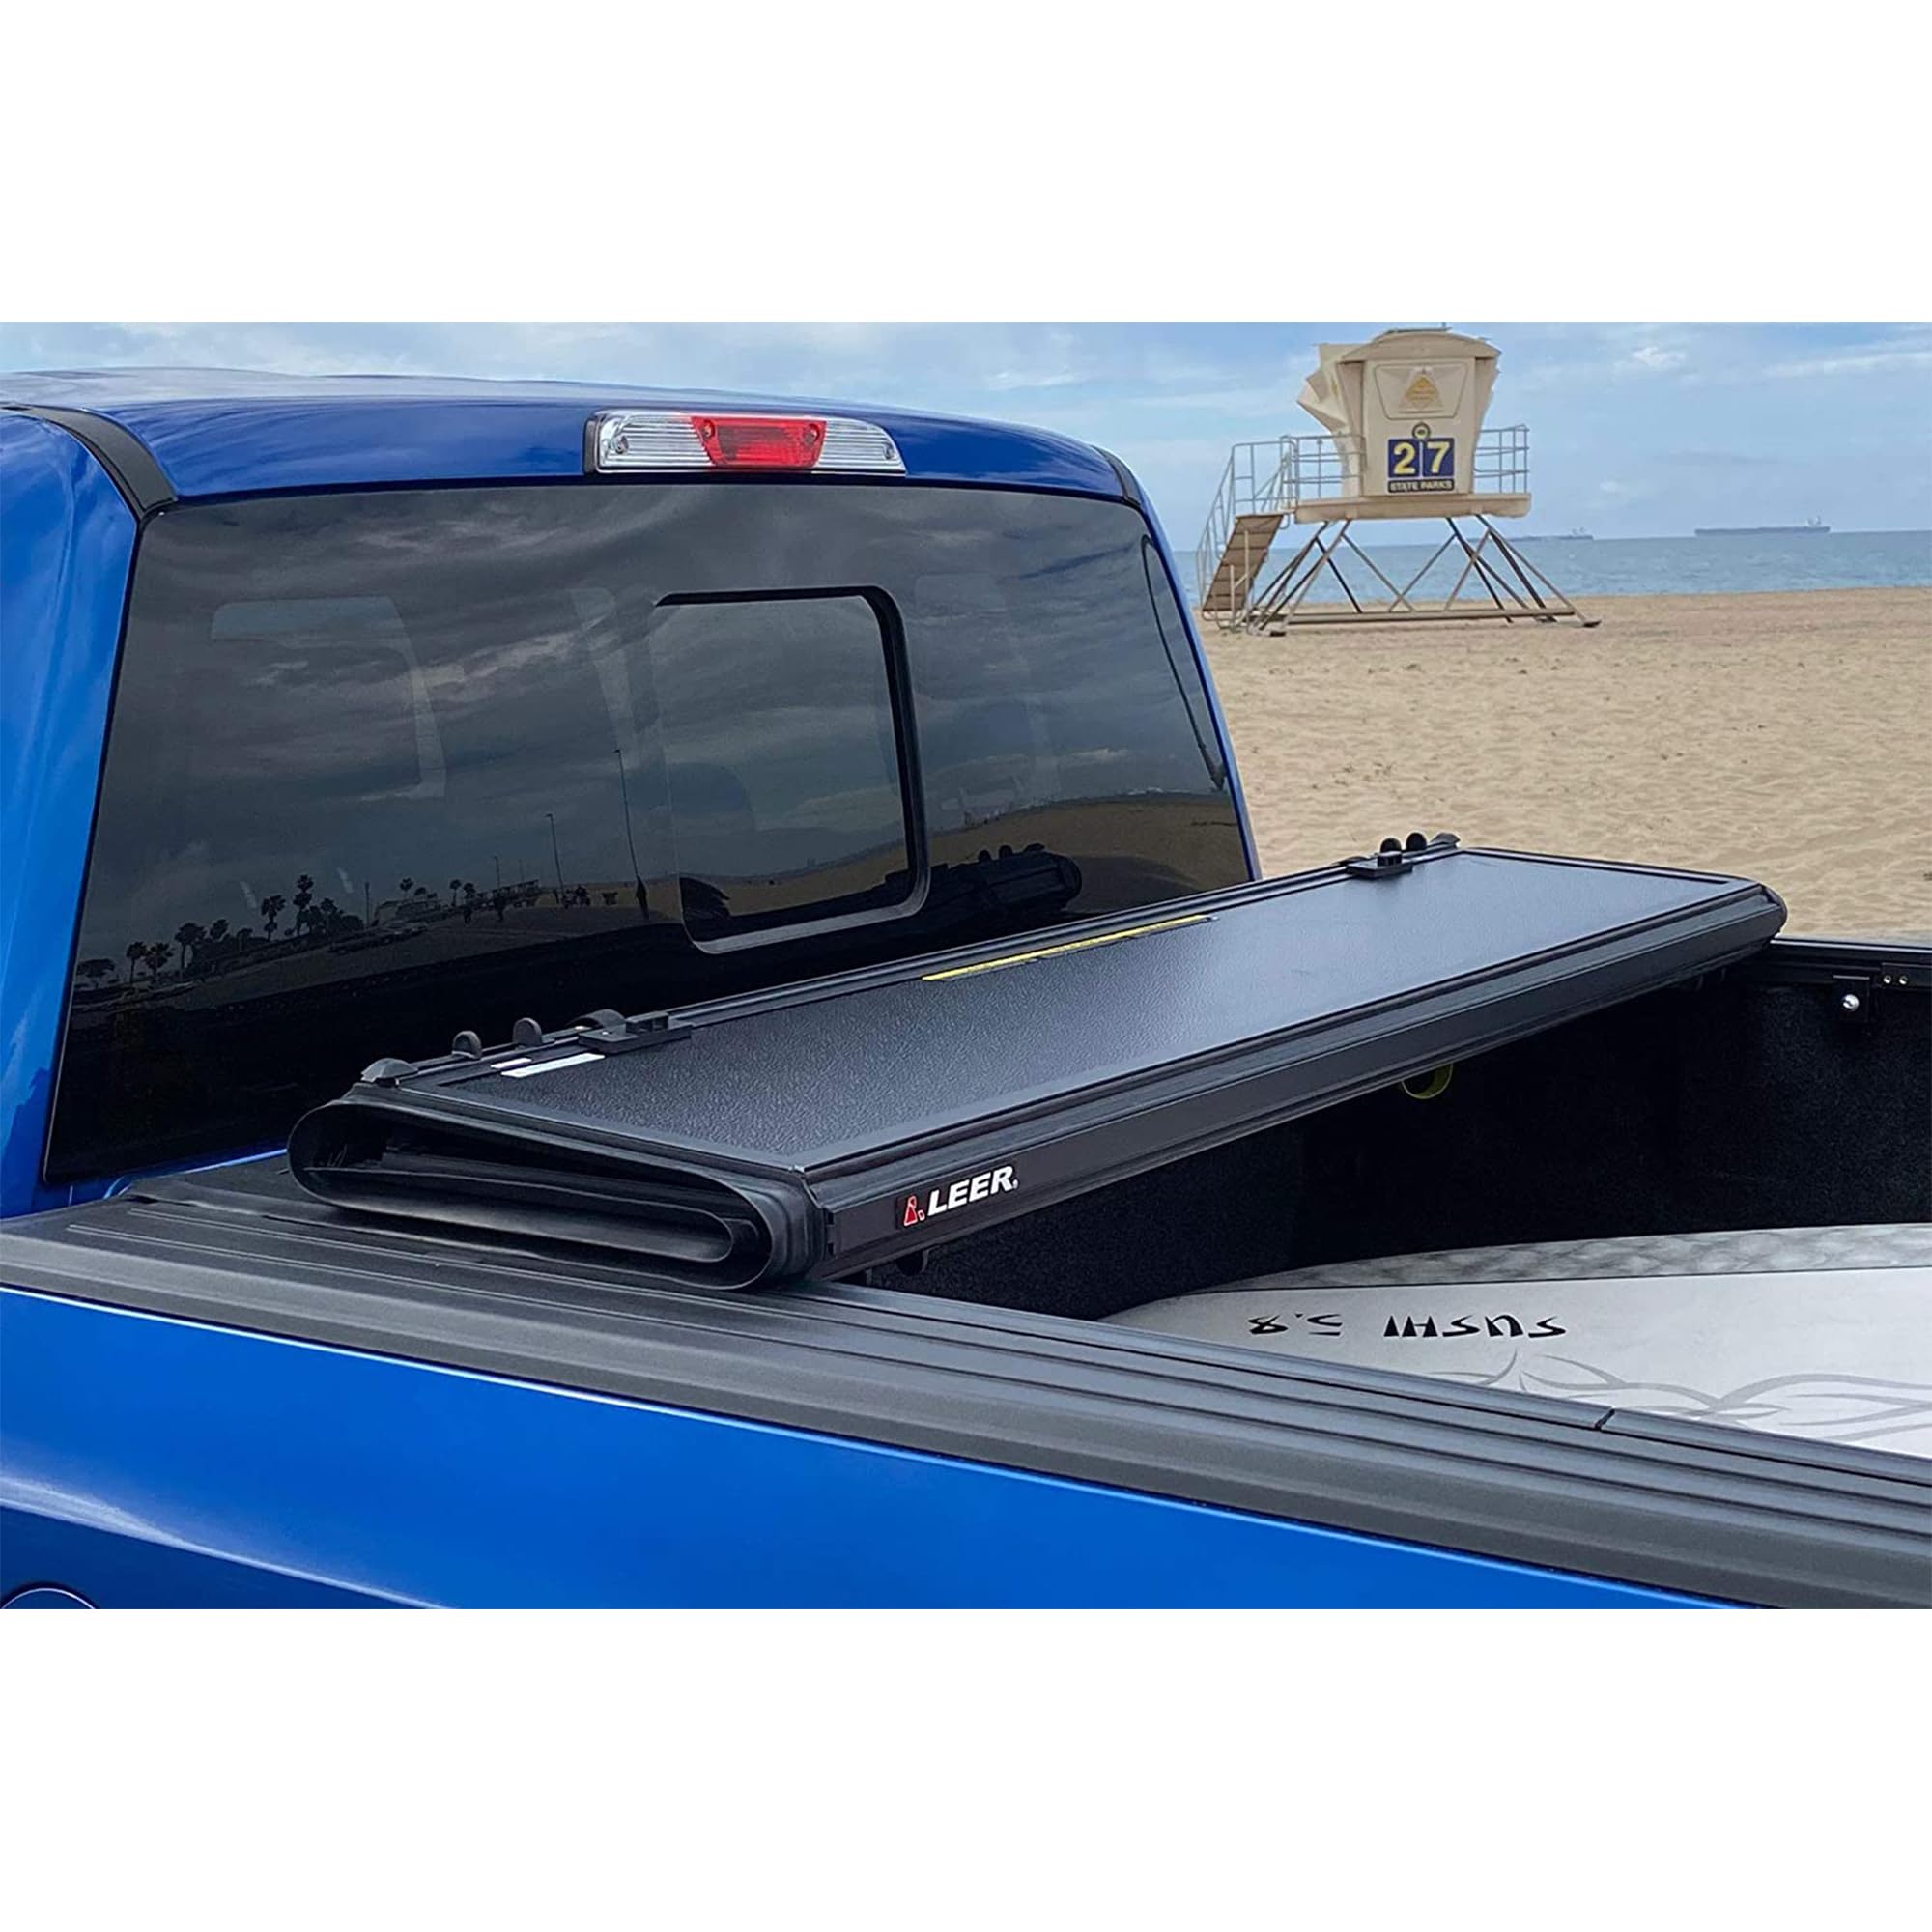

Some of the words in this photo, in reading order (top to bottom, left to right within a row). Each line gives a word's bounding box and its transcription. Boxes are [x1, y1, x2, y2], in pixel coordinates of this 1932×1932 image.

[1393, 441, 1451, 474] 27
[1248, 1313, 1344, 1336] 5.8
[1383, 1315, 1567, 1339] SUSHI
